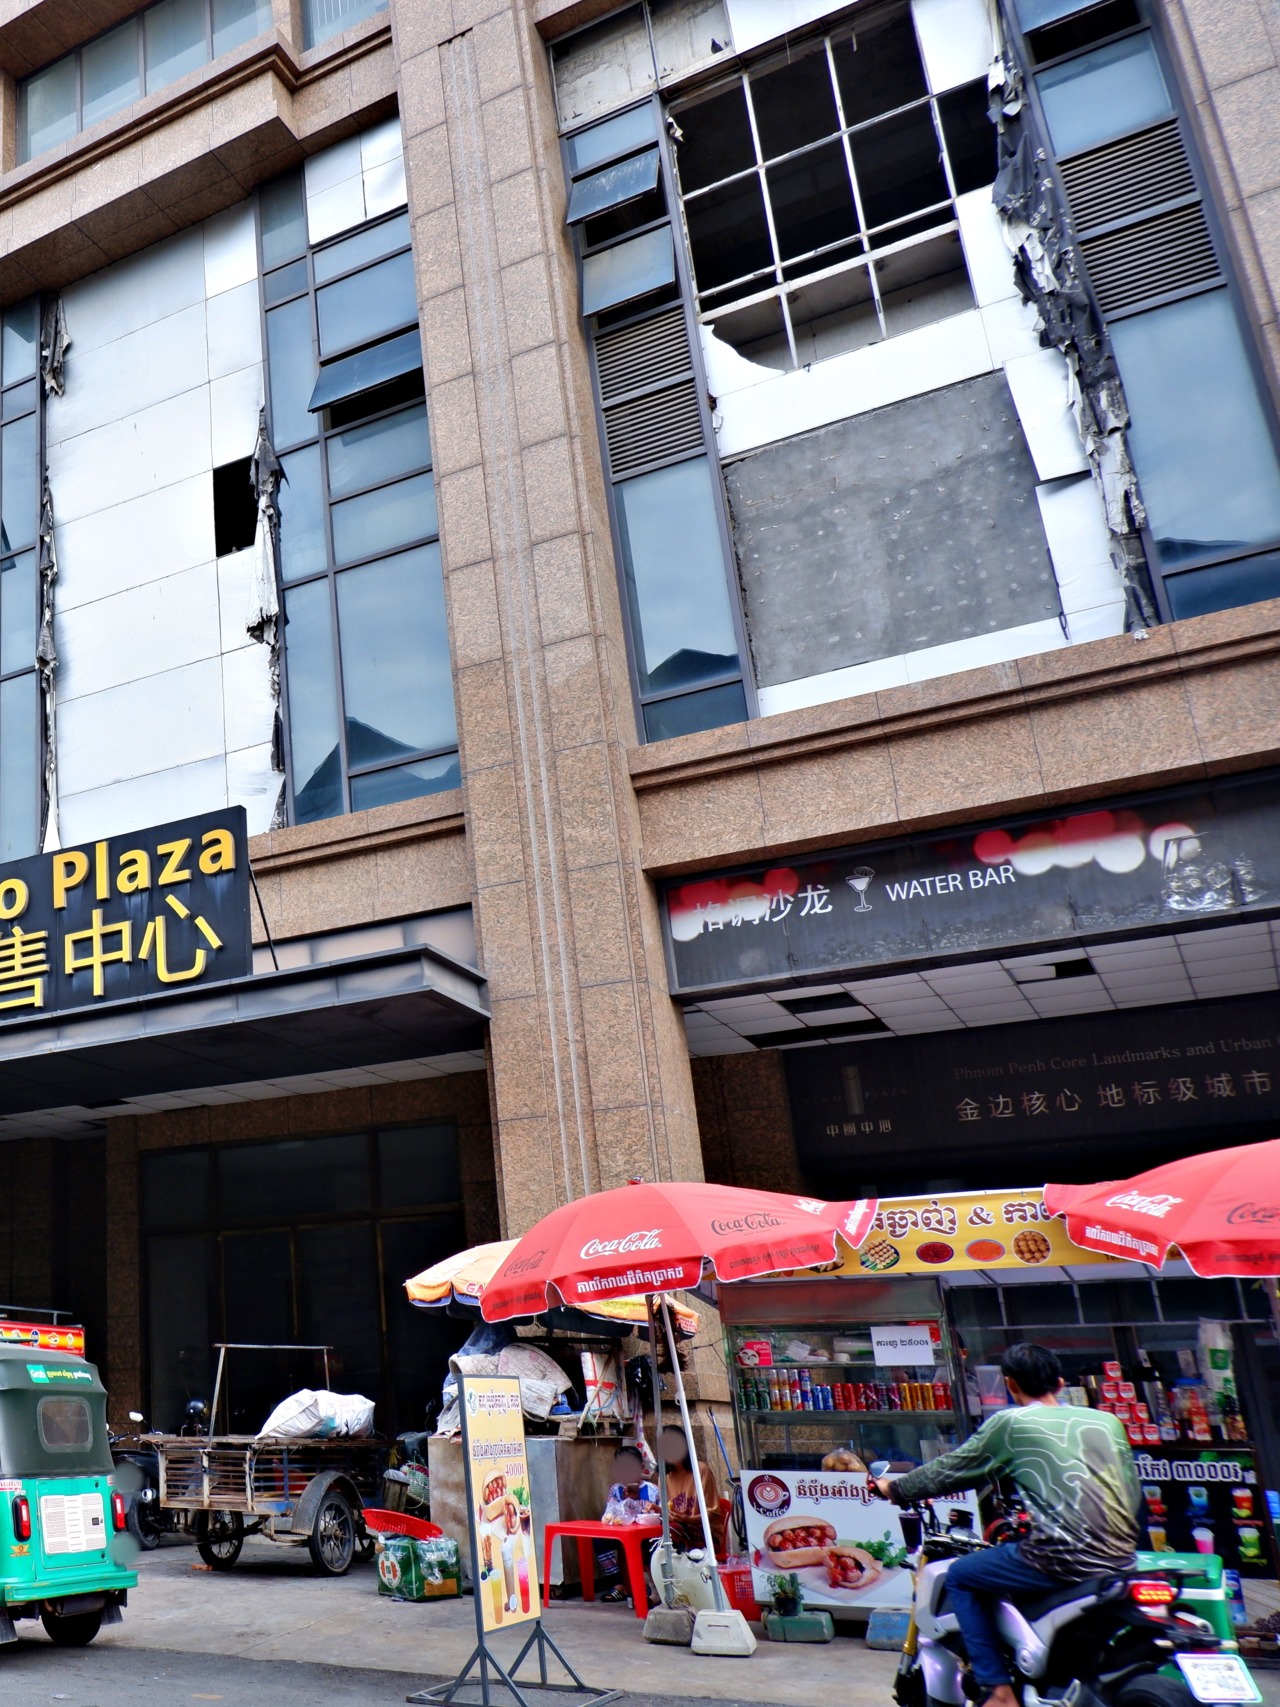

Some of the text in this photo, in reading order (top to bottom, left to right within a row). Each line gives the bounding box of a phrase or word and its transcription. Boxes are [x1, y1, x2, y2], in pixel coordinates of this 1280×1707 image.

[52, 828, 236, 909] Plaza
[885, 864, 1016, 902] WATER BAR
[693, 884, 833, 934] 格调沙龙
[954, 1036, 1271, 1080] Phnom Penh Core Landmarks and Urban
[955, 1069, 1271, 1122] 金边核心 地标级城市
[968, 1206, 994, 1226] &
[1105, 1190, 1184, 1218] Coca-Cola
[711, 1212, 781, 1236] Coca-Cola
[580, 1228, 662, 1260] Coca-Cola
[503, 1249, 549, 1278] Coca-Cola
[752, 1503, 790, 1518] i-Coffee
